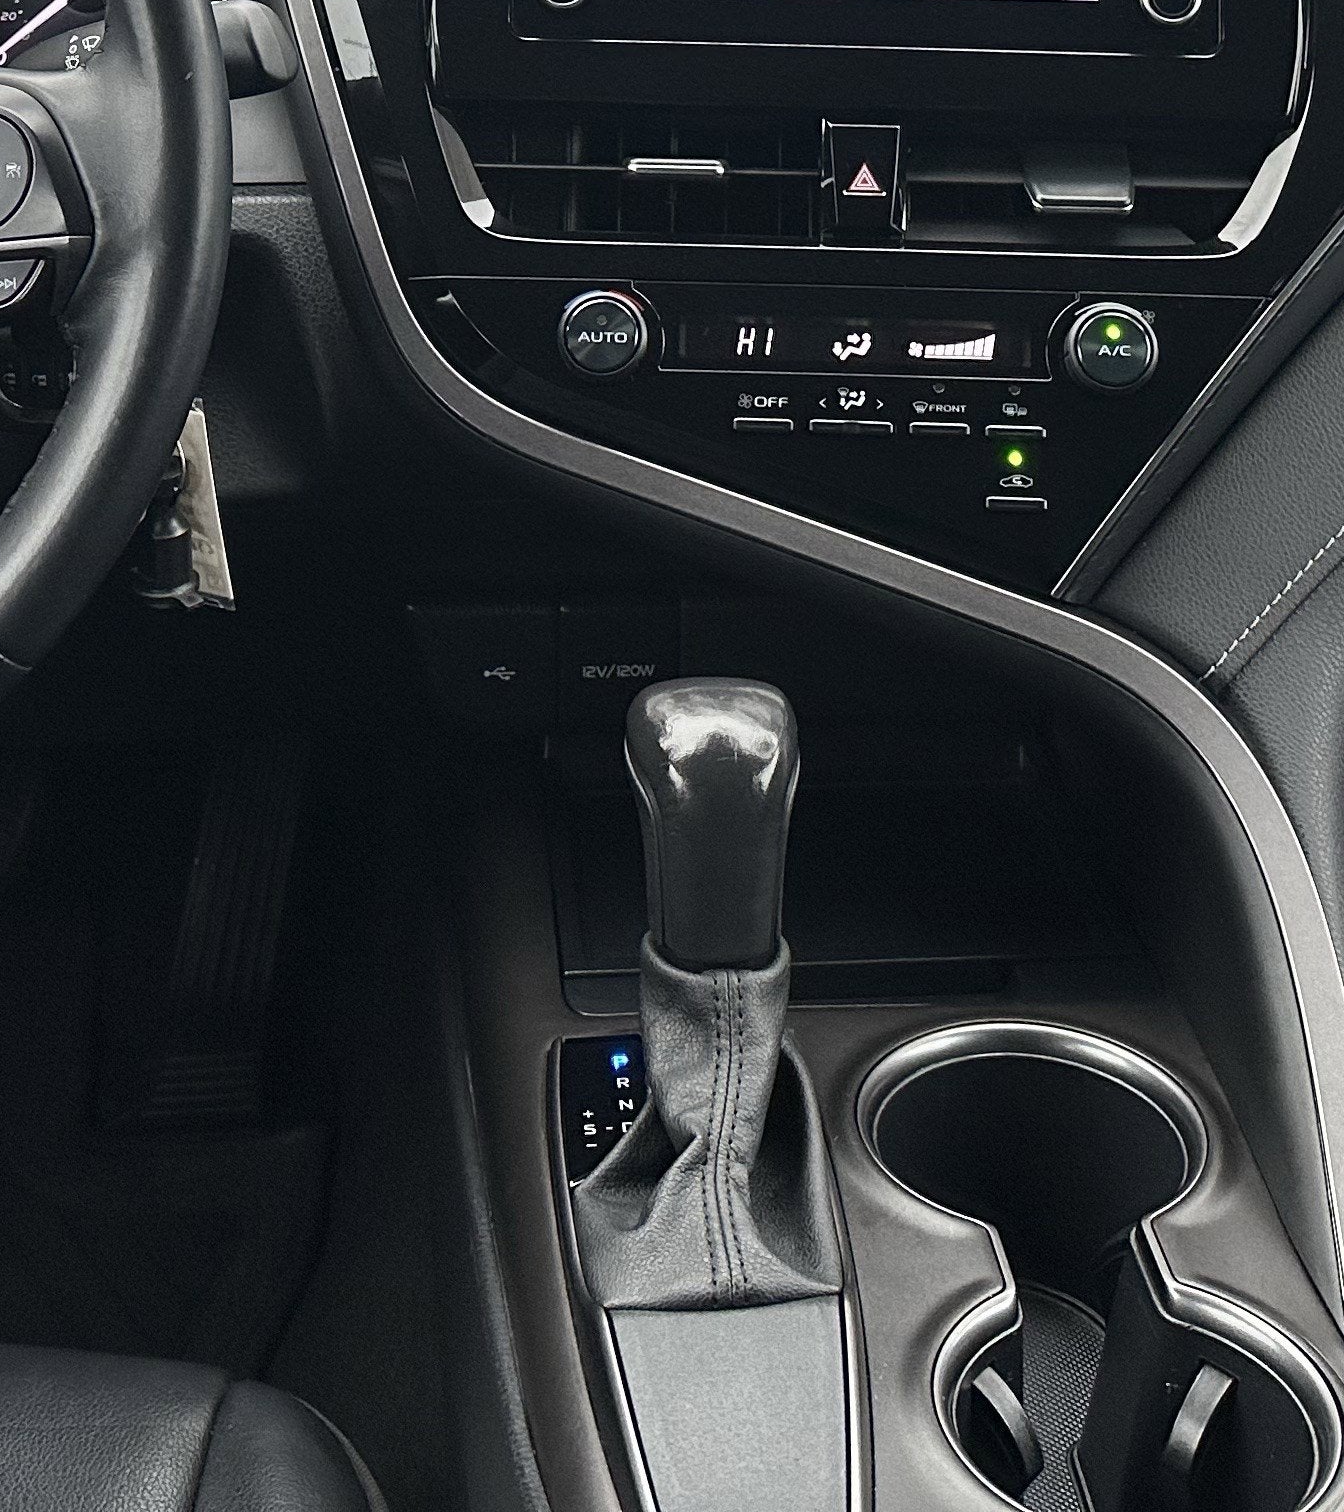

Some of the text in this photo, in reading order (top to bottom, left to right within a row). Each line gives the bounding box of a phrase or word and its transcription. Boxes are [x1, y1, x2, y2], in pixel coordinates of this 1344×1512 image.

[0, 11, 18, 22] 20
[576, 330, 629, 345] AUTO
[1097, 343, 1133, 358] A/C
[754, 395, 789, 409] OFF
[928, 404, 967, 414] FRONT
[582, 663, 656, 679] 12V/120W
[610, 1053, 629, 1072] P
[616, 1077, 630, 1089] R
[619, 1099, 634, 1111] N
[583, 1123, 597, 1136] S
